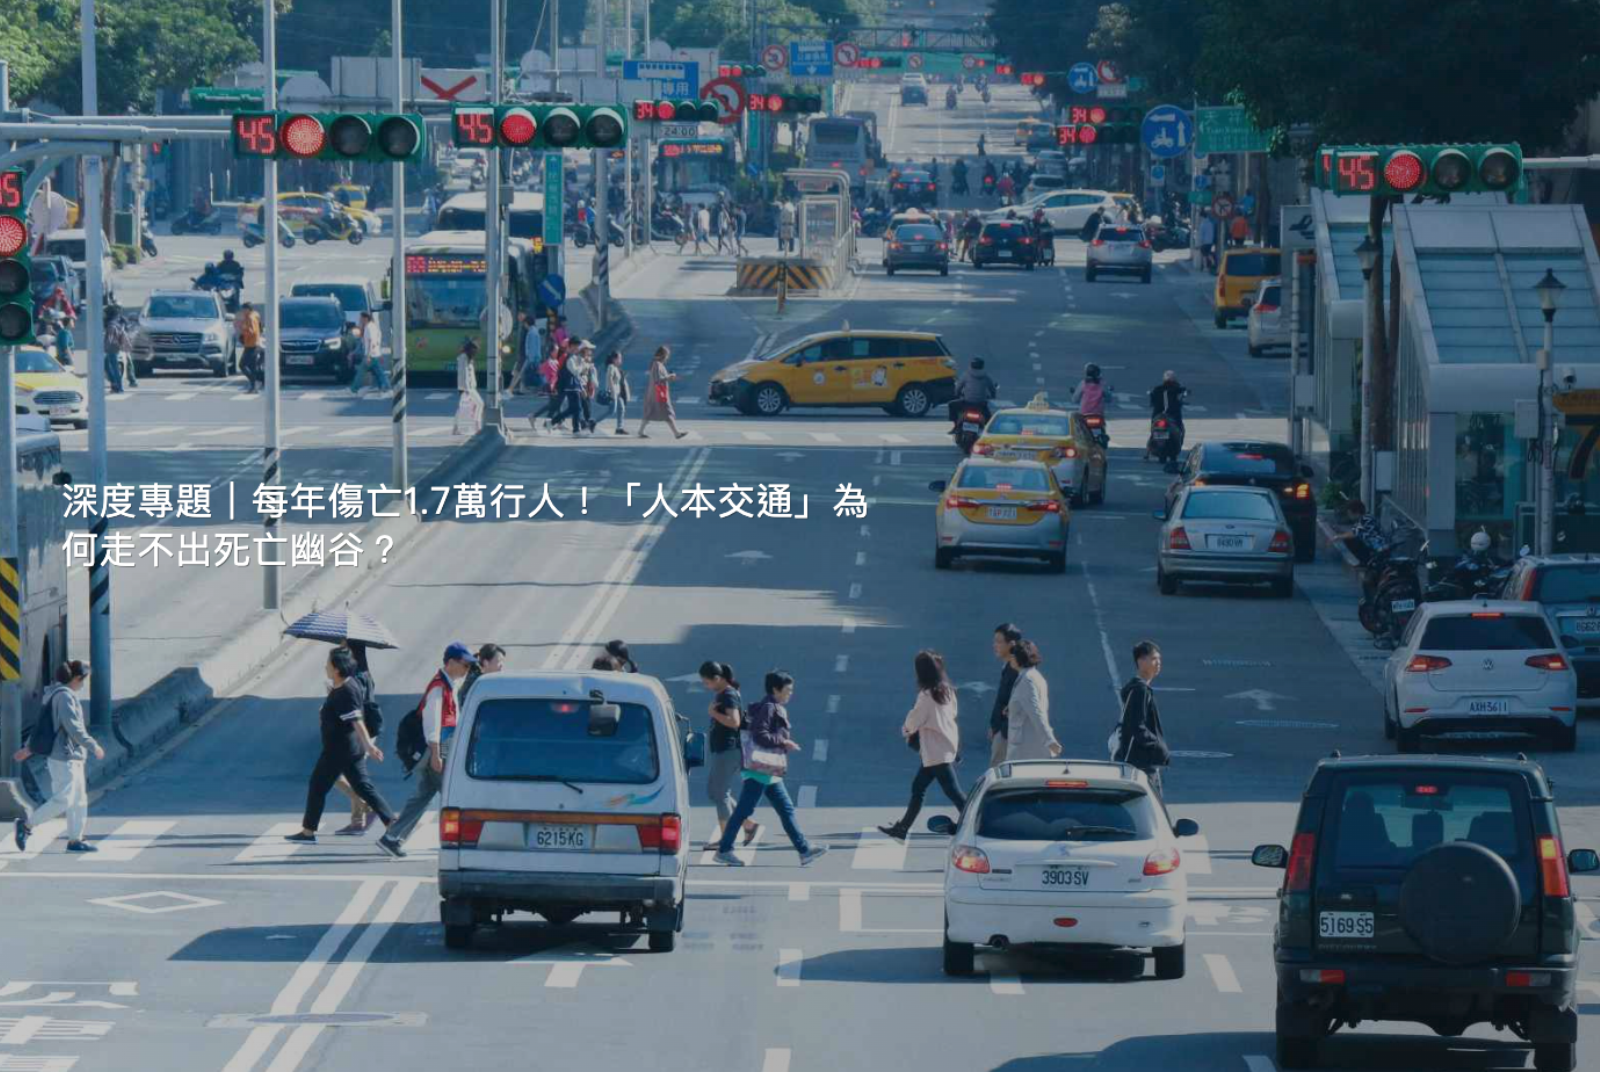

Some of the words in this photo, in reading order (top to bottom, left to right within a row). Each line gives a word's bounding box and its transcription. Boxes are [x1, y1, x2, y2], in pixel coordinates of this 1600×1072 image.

[637, 103, 653, 119] 34
[750, 95, 765, 109] 34
[1072, 108, 1087, 124] 34
[239, 117, 274, 154] 45
[457, 112, 493, 144] 45
[1058, 126, 1076, 144] 34
[1338, 153, 1375, 190] 45
